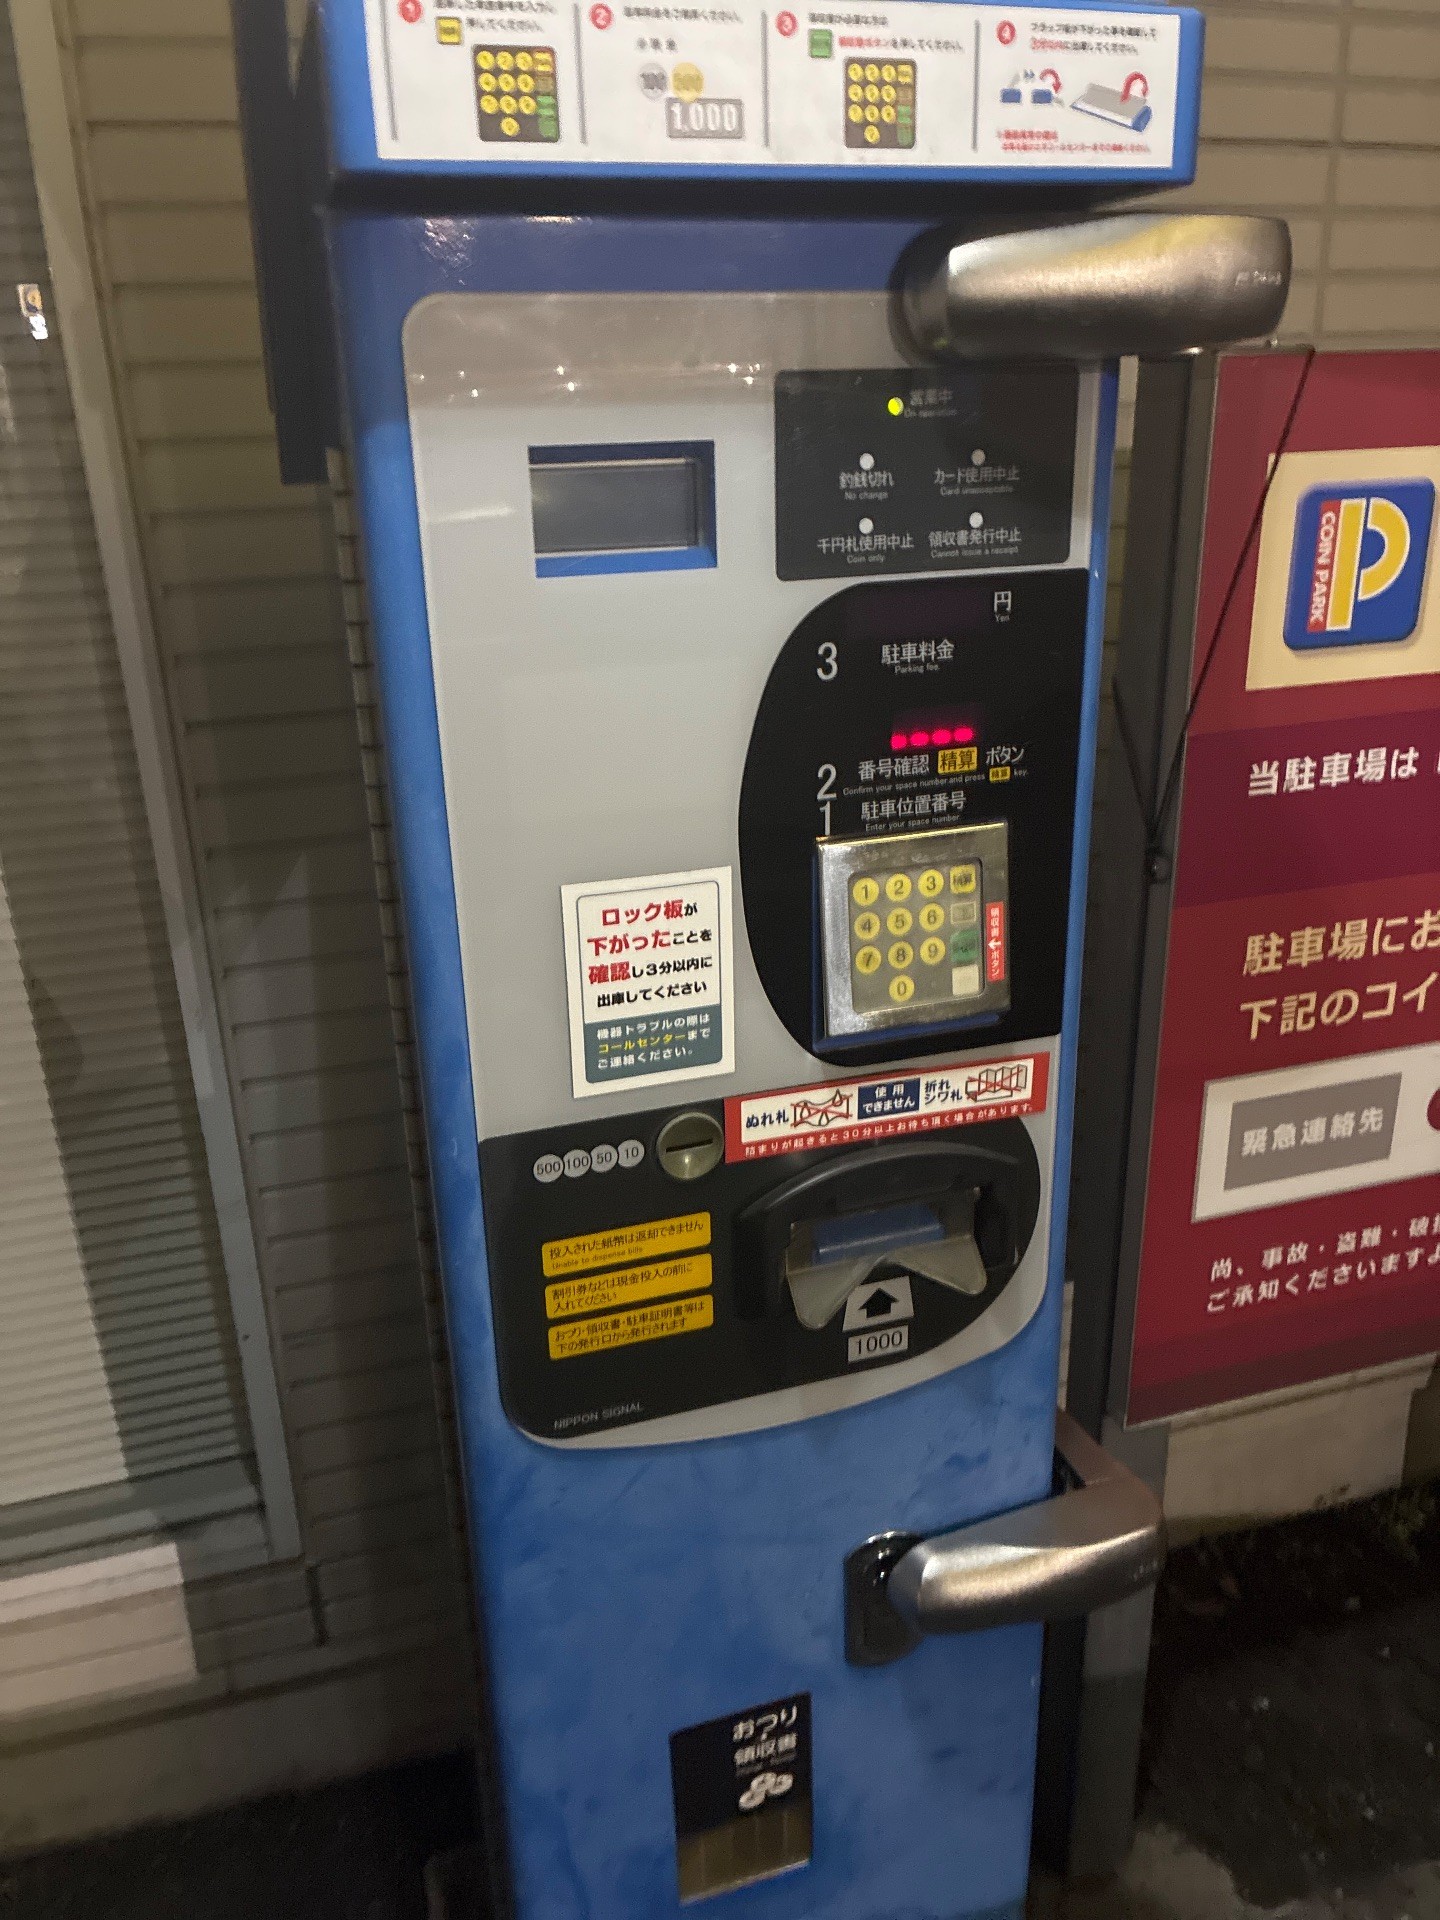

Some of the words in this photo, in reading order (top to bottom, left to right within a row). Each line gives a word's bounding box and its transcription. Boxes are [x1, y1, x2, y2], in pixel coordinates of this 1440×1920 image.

[934, 466, 1020, 484] カード使用中止
[817, 533, 914, 555] 千円札使用中止
[928, 527, 1021, 548] 領収書発行中止
[1316, 511, 1336, 568] COIN
[847, 554, 866, 564] Coin
[993, 590, 1012, 613] 円
[1309, 572, 1330, 624] PARK
[817, 641, 838, 681] 3
[881, 639, 955, 665] 駐車料金
[895, 664, 924, 674] Parking
[858, 754, 930, 782] 番号確認
[940, 749, 974, 772] 精算
[986, 745, 1025, 766] ボタン
[1249, 747, 1419, 797] 当駐車場は
[816, 763, 837, 801] 2
[842, 786, 874, 796] Confirm
[875, 783, 892, 793] your
[895, 781, 917, 791] space
[919, 777, 947, 788] number
[949, 775, 963, 784] and
[964, 773, 986, 783] press
[818, 801, 831, 836] 1
[861, 790, 967, 821] 駐車位置番号
[865, 823, 886, 832] Enter
[888, 821, 905, 831] your
[908, 818, 930, 828] space
[926, 876, 936, 891] 3
[602, 899, 697, 927] ロック板が
[587, 929, 712, 957] 下がったことを
[1243, 909, 1440, 977] 駐車場にお
[588, 956, 712, 985] 確認し3分以内に
[991, 951, 1000, 976] ボタン
[597, 981, 707, 1008] 出庫してください
[1240, 972, 1439, 1042] 下記のコイ
[597, 1013, 710, 1040] 機器トラブルの際は
[599, 1027, 710, 1054] コールセンターまで
[745, 1108, 789, 1129] ぬれ札
[874, 1083, 904, 1099] 使用
[924, 1078, 951, 1094] 折れ
[862, 1097, 915, 1115] できません
[924, 1088, 962, 1106] シワ札
[1241, 1106, 1385, 1157] 緊急連絡先
[536, 1160, 561, 1174] 500
[567, 1155, 590, 1169] 100
[595, 1152, 613, 1165] 50
[624, 1147, 639, 1159] 10
[549, 1220, 704, 1261] 投入された紙幣は返却できません
[552, 1262, 693, 1301] 割引券などは現金投入の前に
[553, 1291, 617, 1314] 入れてください
[556, 1317, 687, 1354] 下の発行口から発行されます
[856, 1330, 903, 1355] 1000
[554, 1411, 598, 1429] NIPPON
[733, 1704, 798, 1741] おつり
